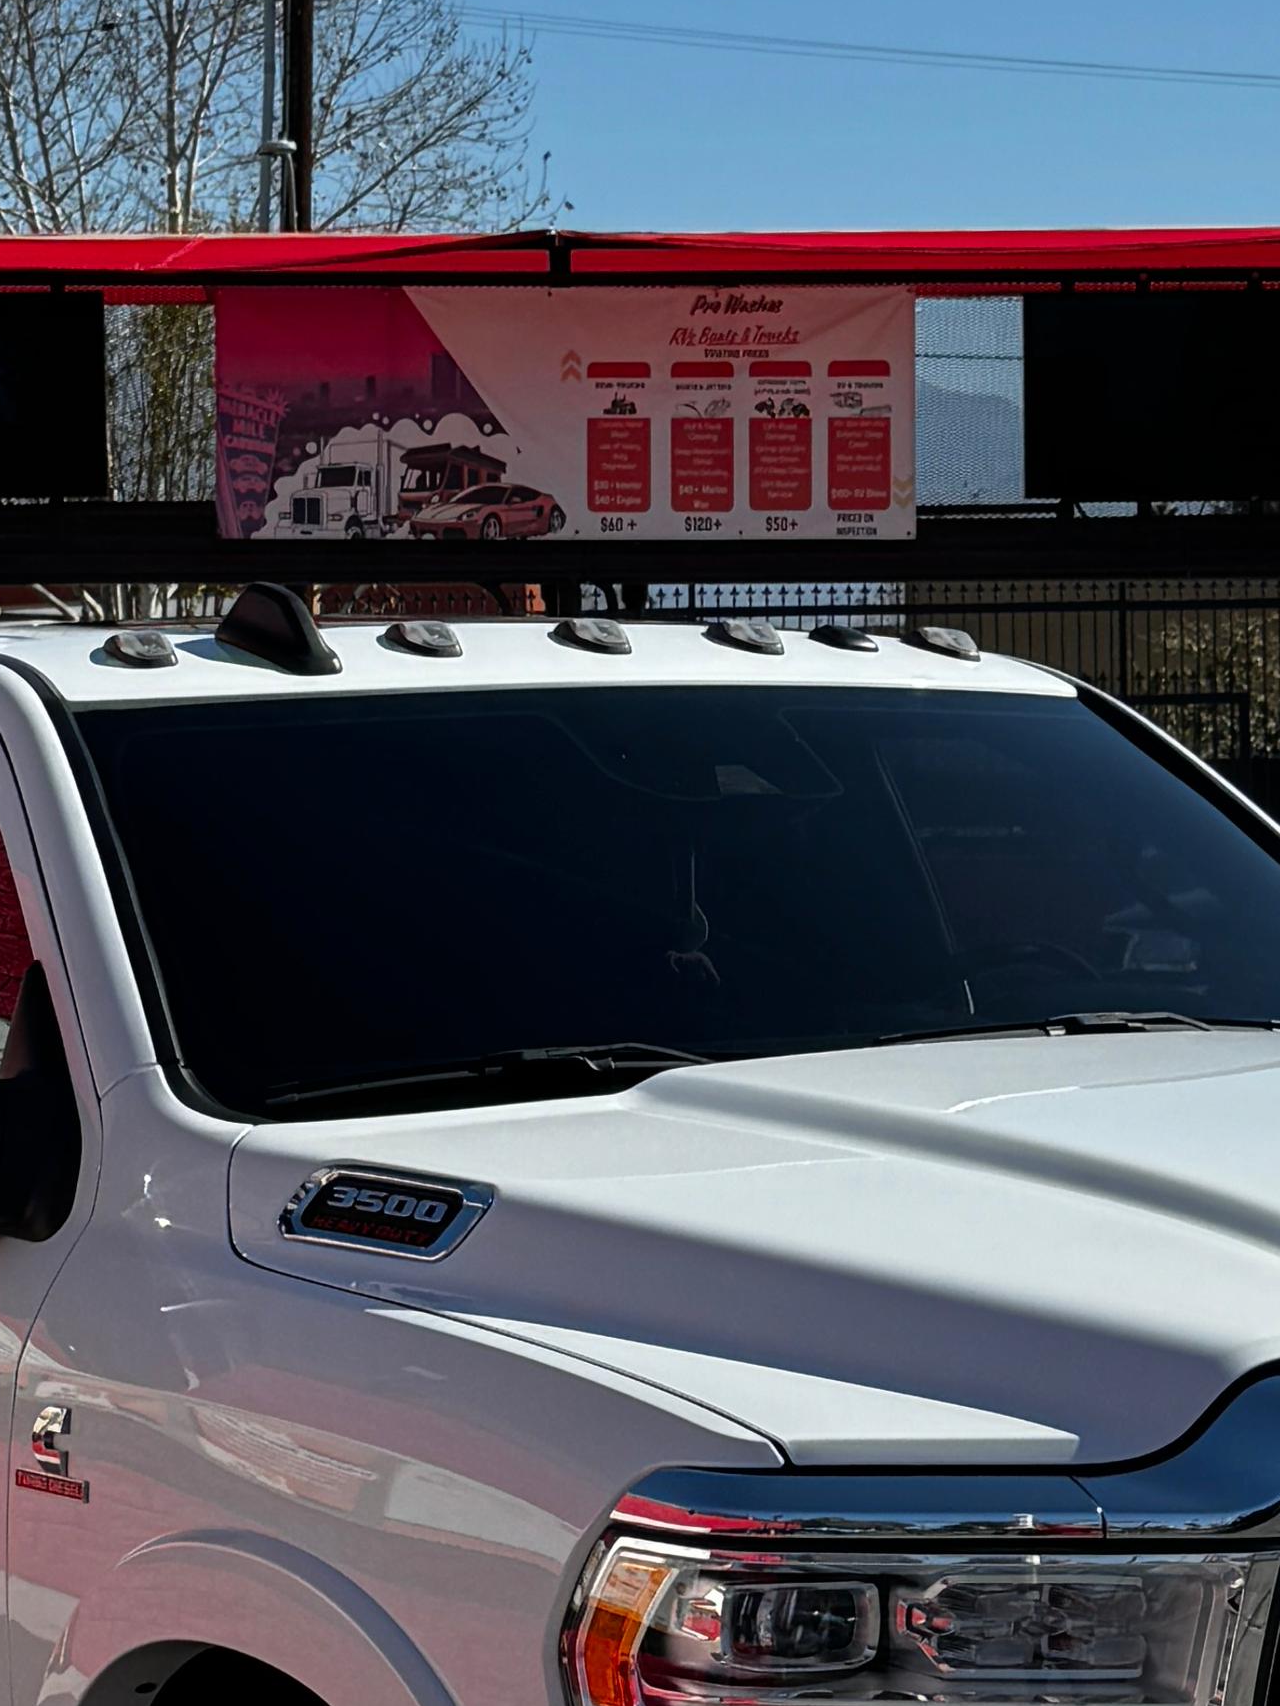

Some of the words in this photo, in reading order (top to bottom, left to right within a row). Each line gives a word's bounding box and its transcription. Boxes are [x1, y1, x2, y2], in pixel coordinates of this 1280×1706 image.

[690, 295, 721, 315] Pro
[699, 326, 738, 346] Boats
[753, 325, 800, 345] Trucks
[600, 516, 623, 533] $60
[327, 1186, 448, 1224] 3500
[310, 1215, 375, 1235] HEAVY
[375, 1223, 431, 1243] DUTY
